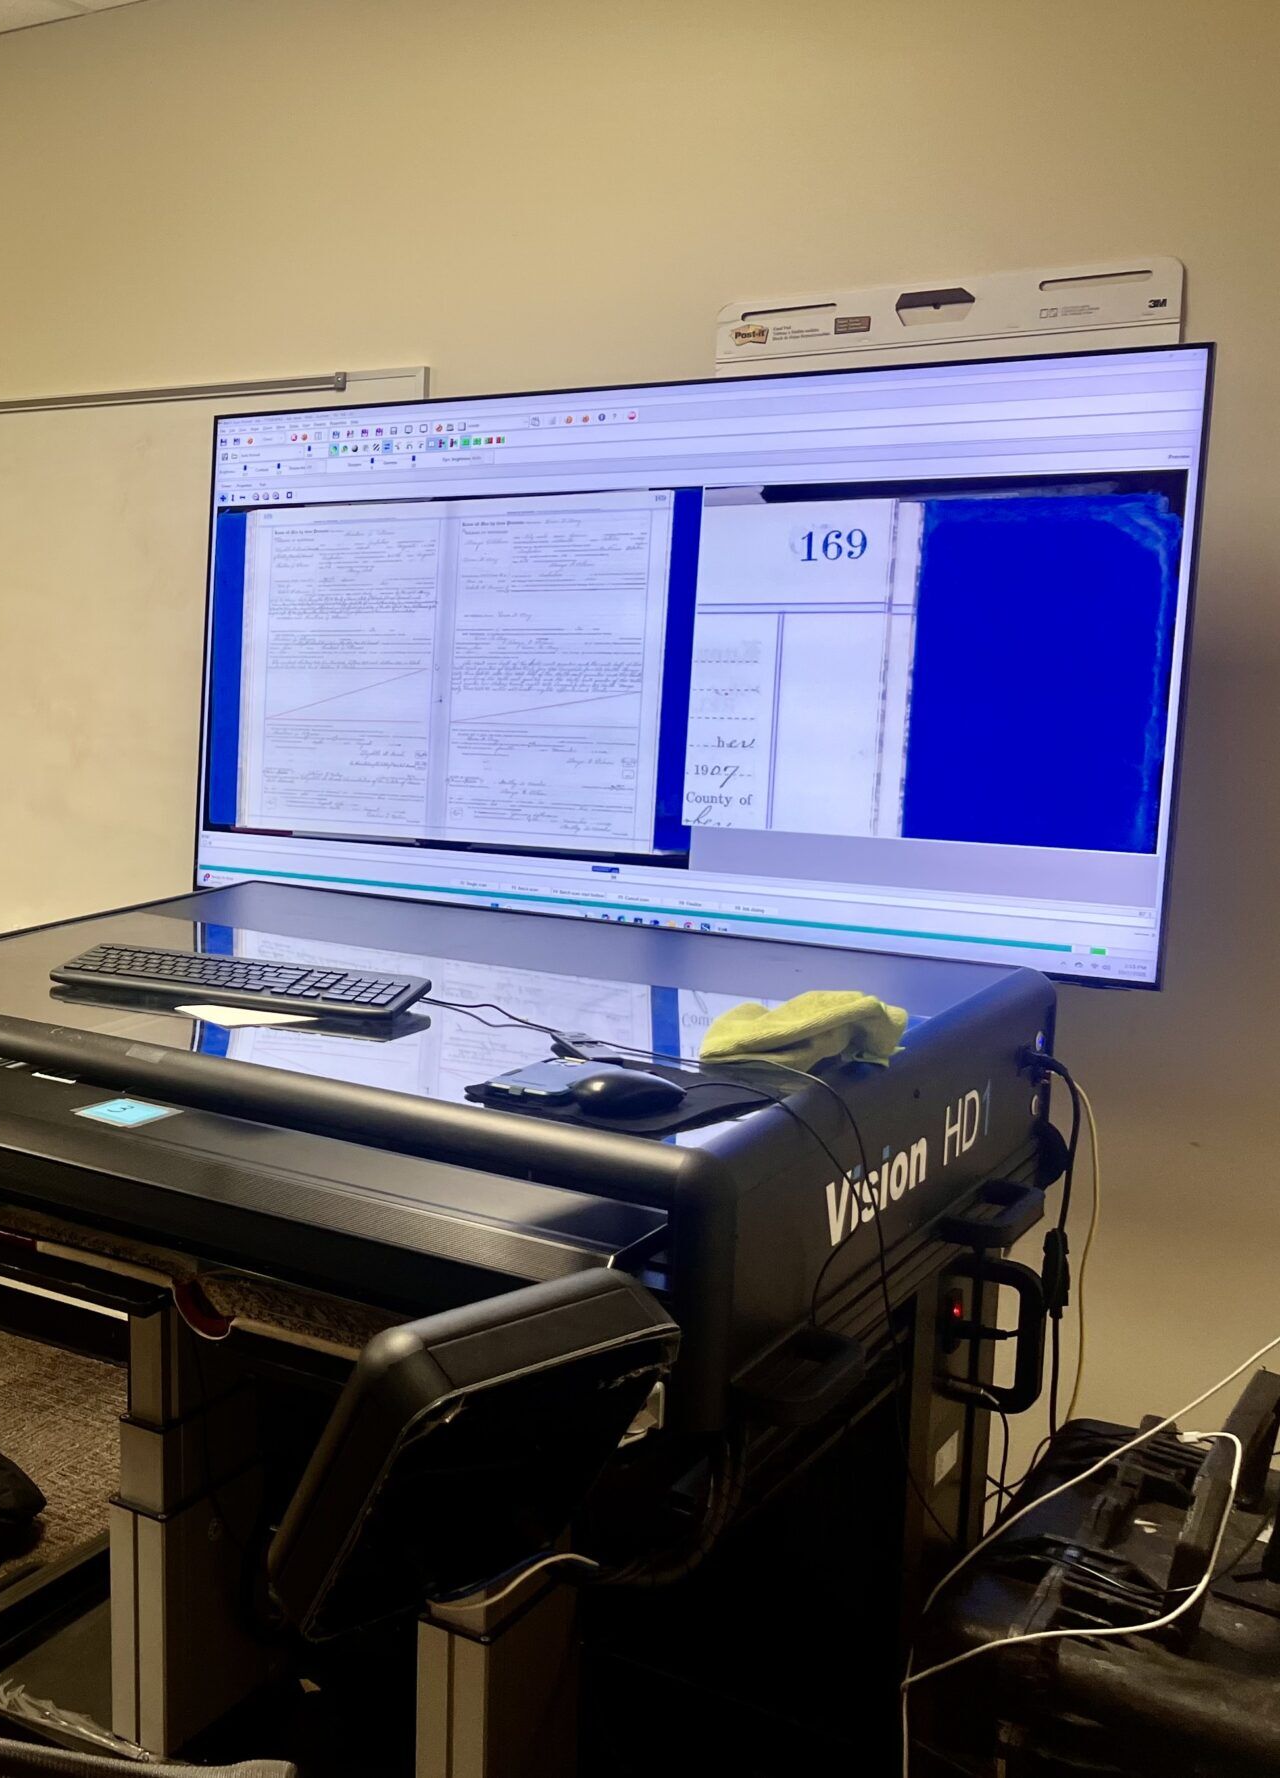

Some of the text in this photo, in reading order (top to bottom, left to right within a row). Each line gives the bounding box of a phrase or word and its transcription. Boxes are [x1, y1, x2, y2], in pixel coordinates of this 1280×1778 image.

[1148, 298, 1168, 308] 3M
[734, 328, 766, 340] Post-it
[800, 528, 869, 562] 169
[694, 764, 740, 789] 1907
[686, 791, 753, 807] County of
[825, 1078, 992, 1247] Vision HD1
